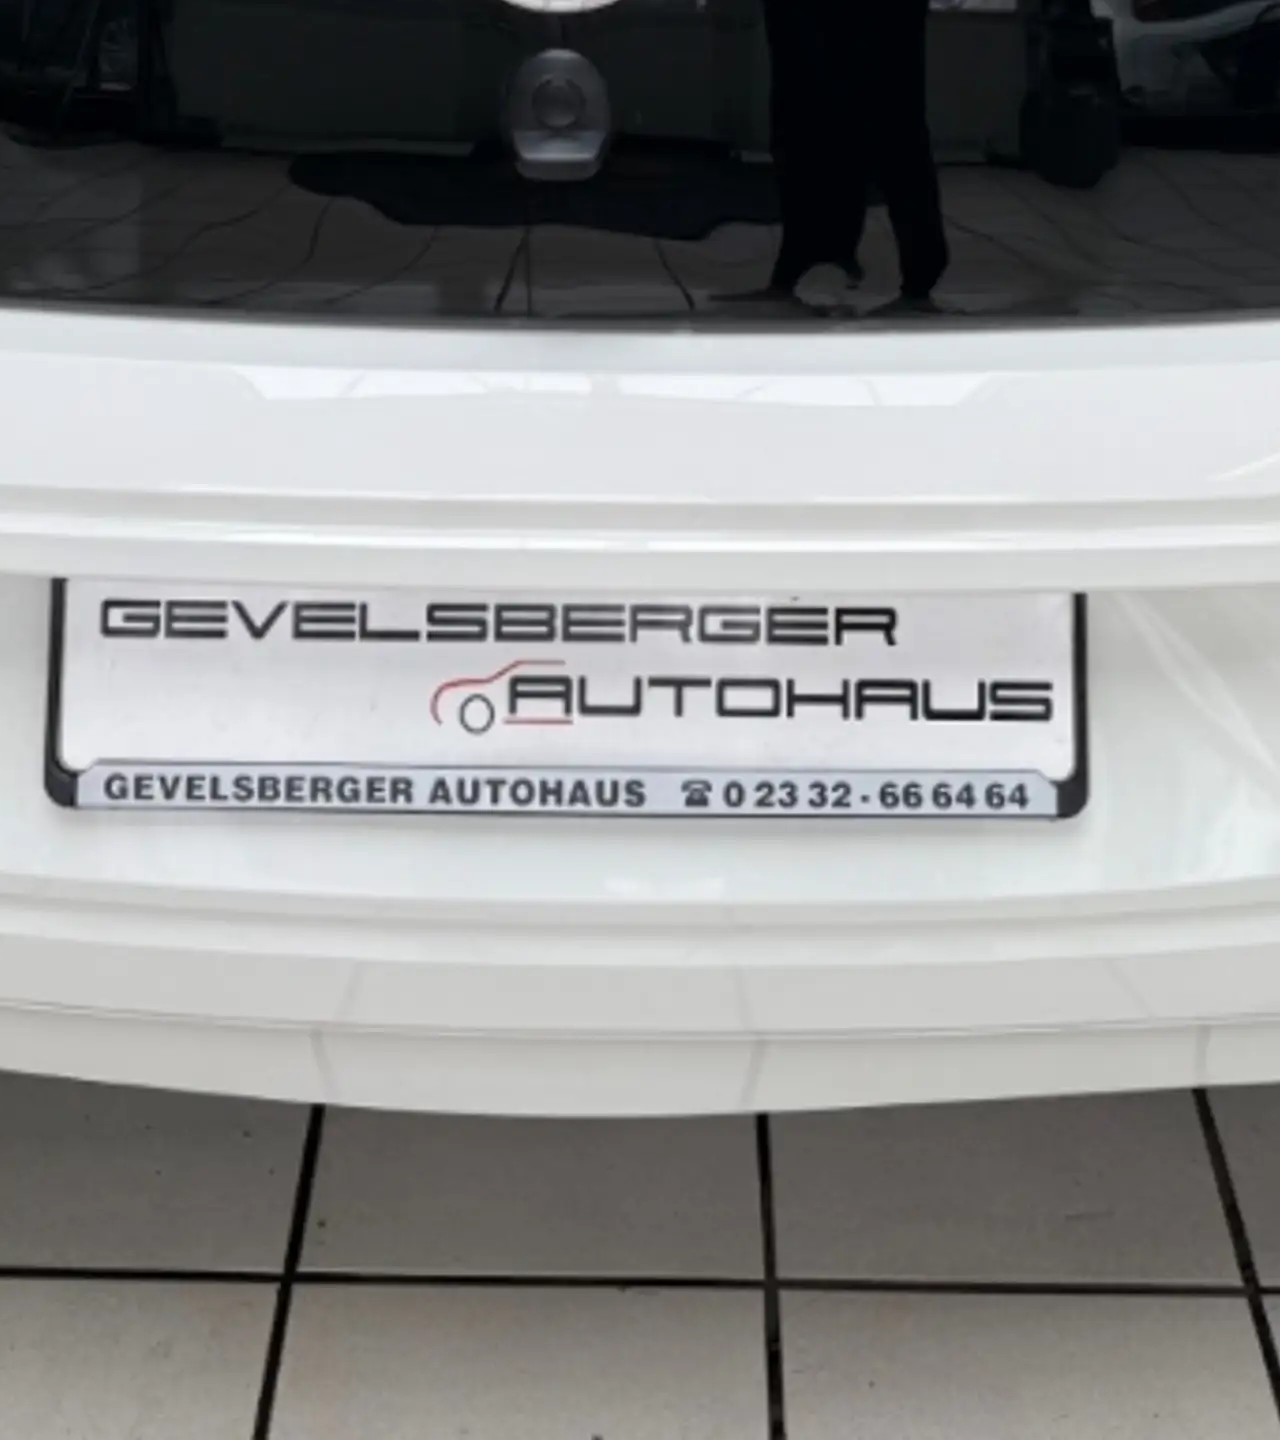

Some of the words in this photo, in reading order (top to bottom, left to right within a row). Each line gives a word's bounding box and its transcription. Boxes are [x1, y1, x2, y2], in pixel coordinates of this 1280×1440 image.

[100, 599, 898, 647] GEVELSBERGER
[508, 676, 1054, 721] AUTOHAUS
[104, 773, 413, 804] GEVELSBERGER
[428, 777, 646, 808] AUTOHAUS
